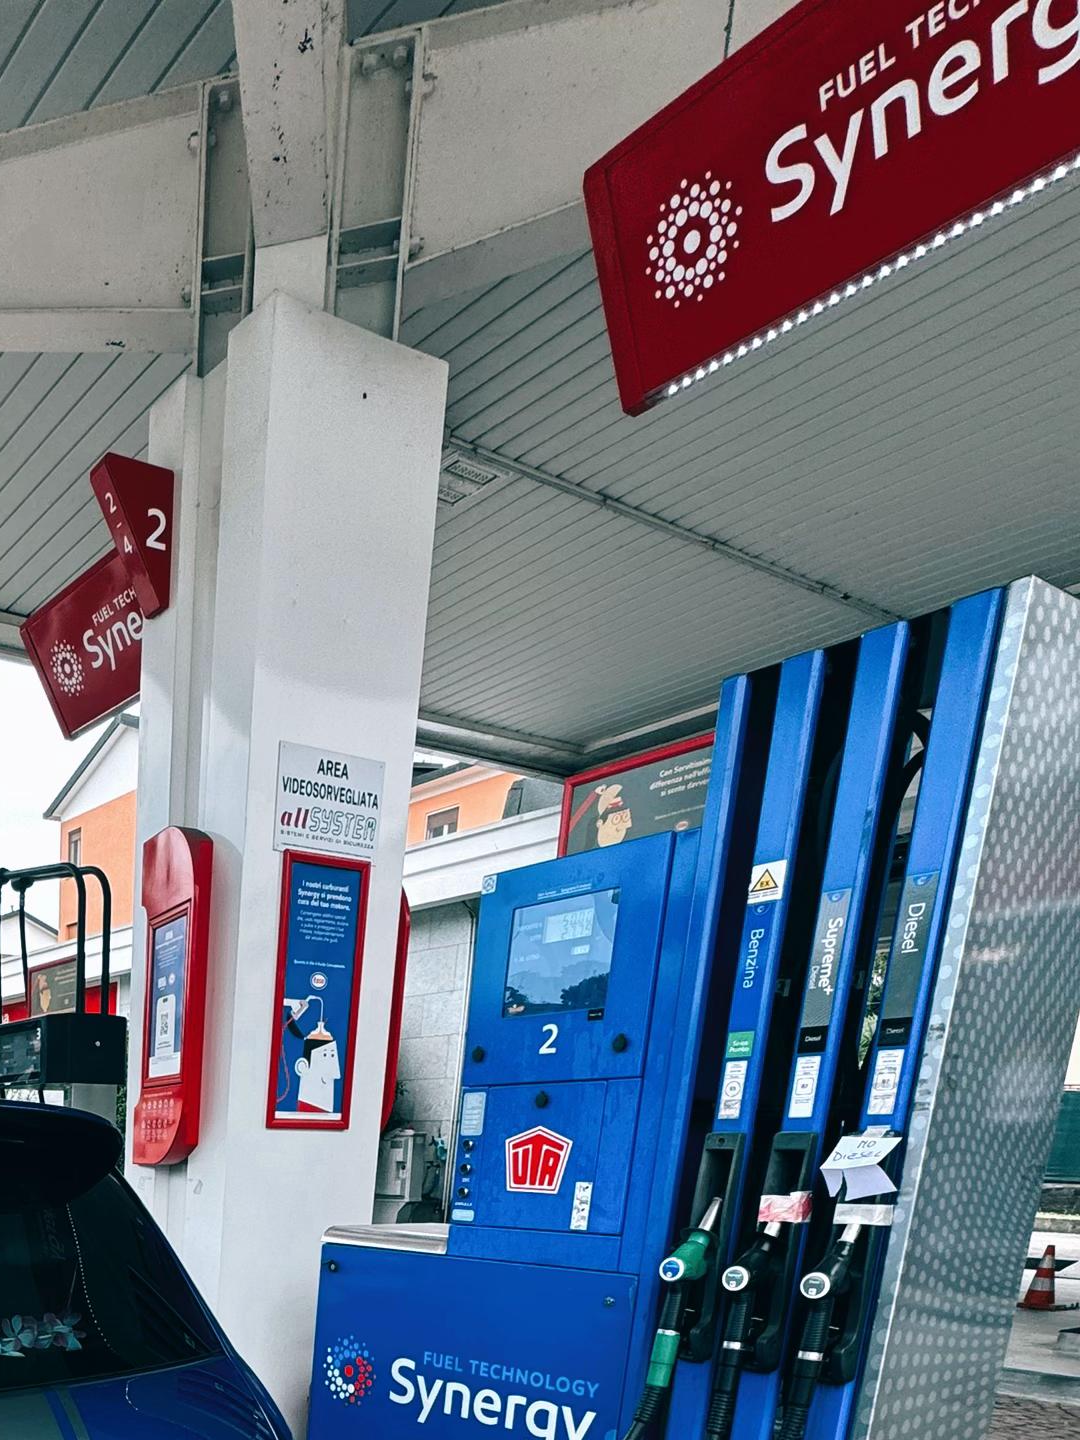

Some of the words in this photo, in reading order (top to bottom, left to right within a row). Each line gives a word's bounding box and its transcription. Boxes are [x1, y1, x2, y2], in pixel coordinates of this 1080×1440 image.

[818, 42, 896, 112] FUEL
[105, 492, 117, 514] 2
[123, 535, 133, 555] 4
[145, 508, 167, 551] 2
[92, 604, 114, 627] FUEL
[282, 776, 379, 810] VIDEOSORVEGLIATA
[317, 758, 349, 780] AREA
[901, 902, 926, 954] Diesel
[742, 928, 765, 989] Benzina
[818, 917, 843, 996] Supreme+
[538, 1023, 559, 1055] 2
[512, 1133, 564, 1186] UTA
[423, 1351, 463, 1372] FUEL
[469, 1359, 600, 1398] TECHNOLOGY
